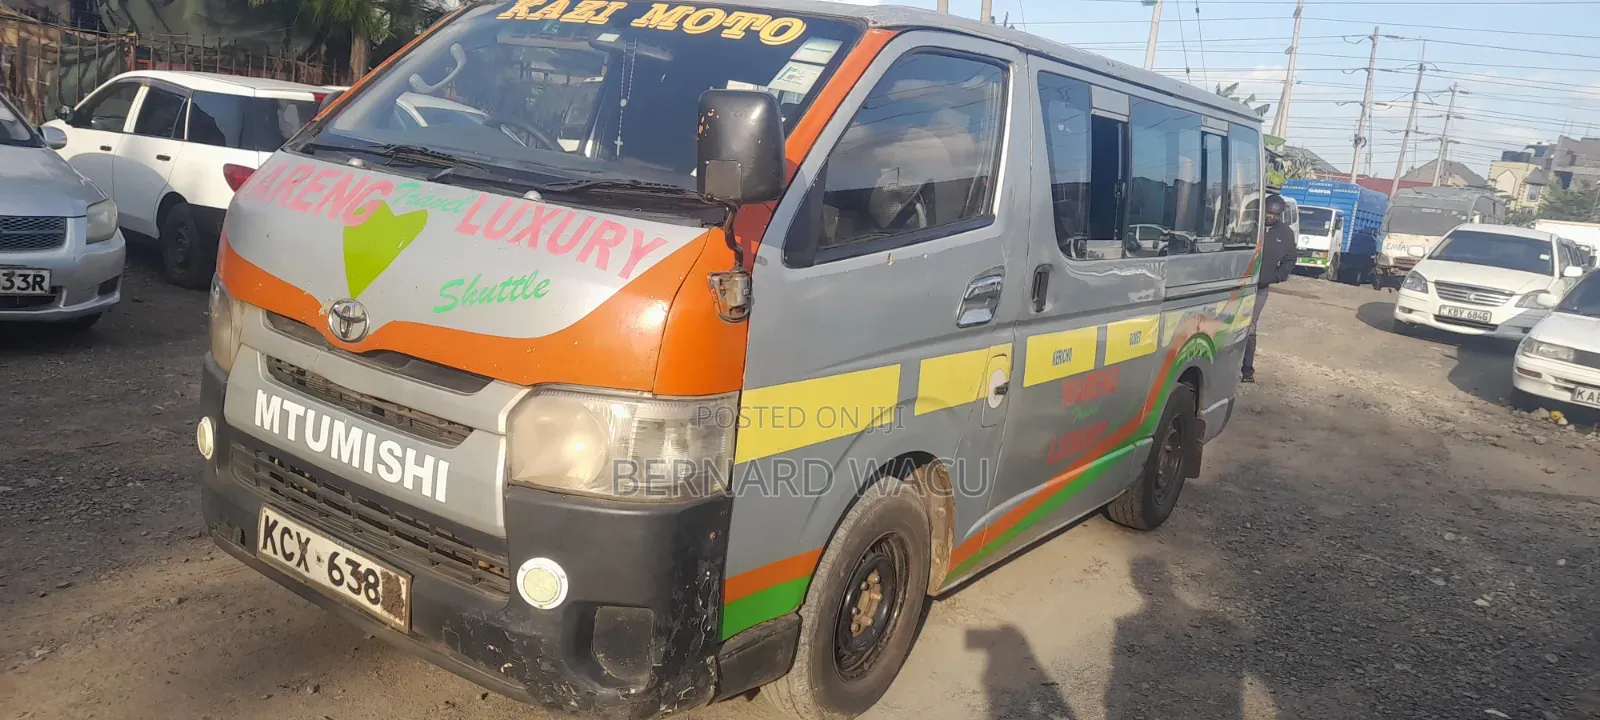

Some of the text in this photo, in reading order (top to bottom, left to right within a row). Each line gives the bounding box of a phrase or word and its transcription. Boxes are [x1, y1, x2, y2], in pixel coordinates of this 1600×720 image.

[496, 0, 807, 46] KAZI MOTO
[392, 182, 481, 214] Travel
[455, 192, 669, 280] LUXURY
[2, 271, 46, 292] 33R
[433, 270, 551, 313] Shuttle
[254, 388, 450, 503] MTUMISHI
[262, 515, 311, 573] KCX
